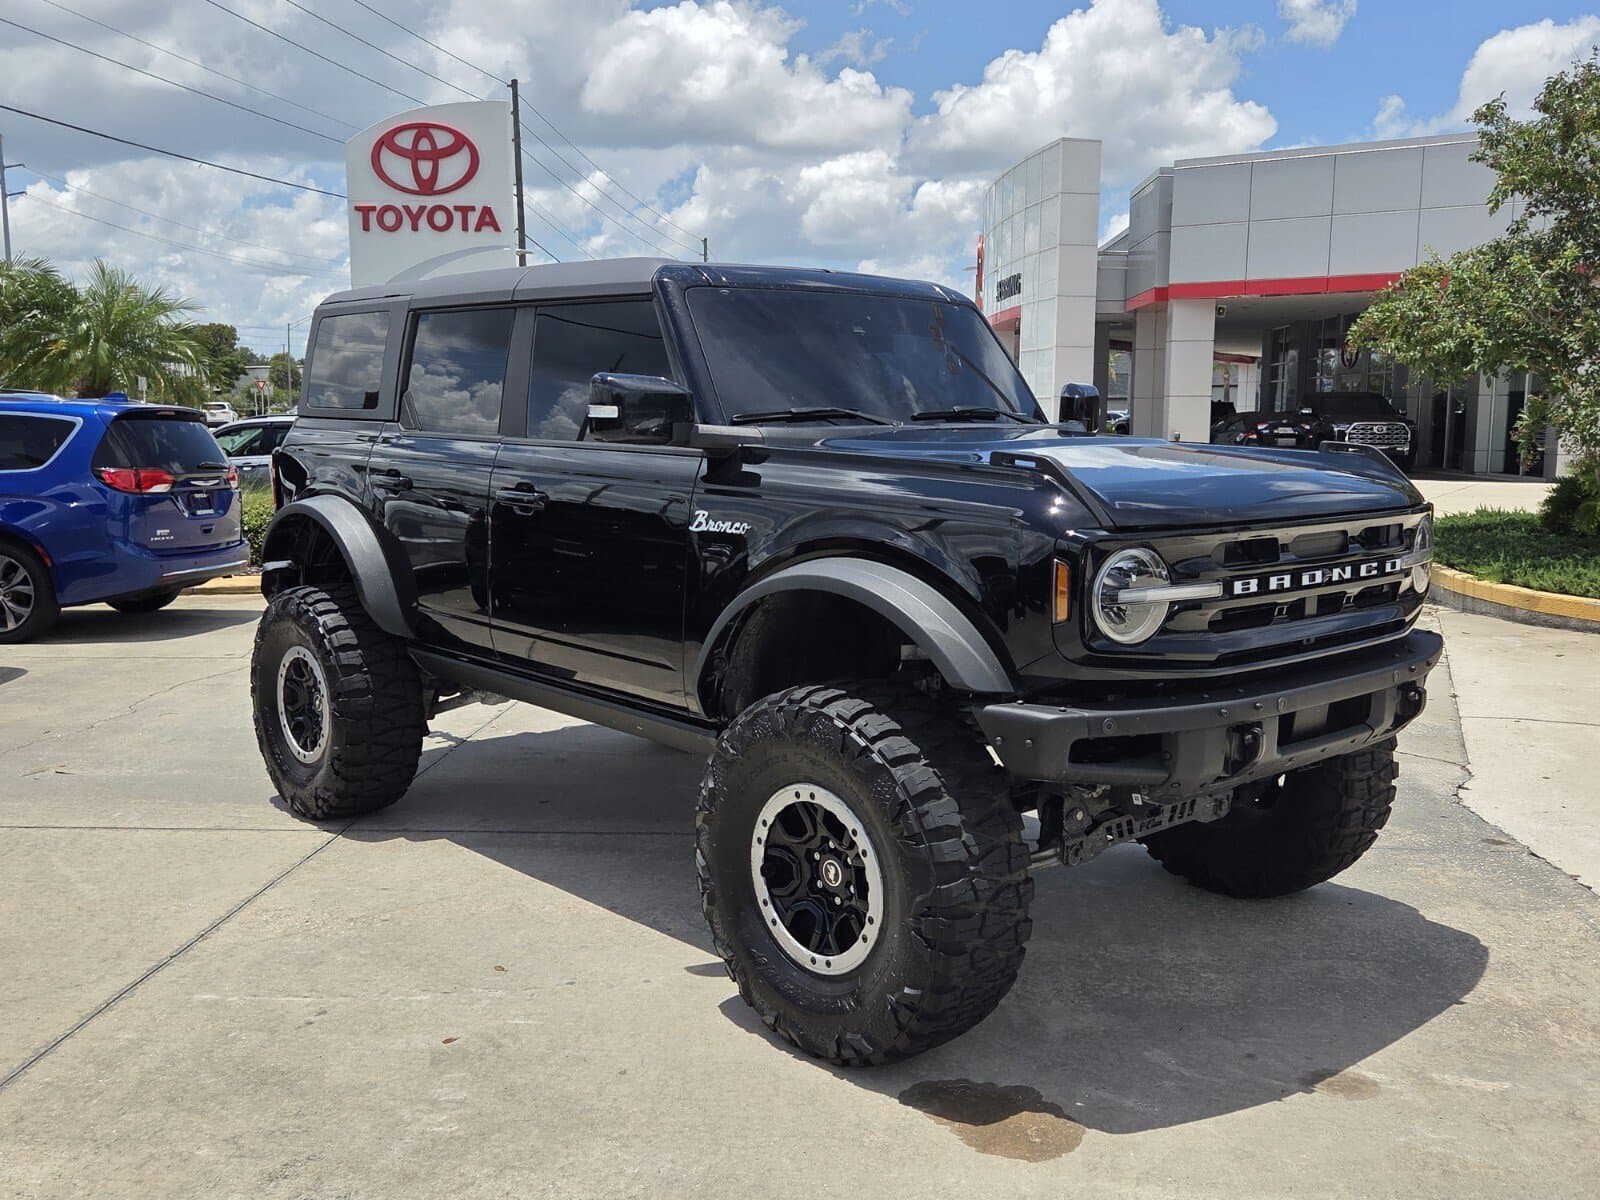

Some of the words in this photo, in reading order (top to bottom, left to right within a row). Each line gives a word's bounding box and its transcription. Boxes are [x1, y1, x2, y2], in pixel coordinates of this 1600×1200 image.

[354, 205, 501, 232] TOYOTA
[689, 510, 752, 534] Bronco
[1233, 558, 1401, 595] BRONCO
